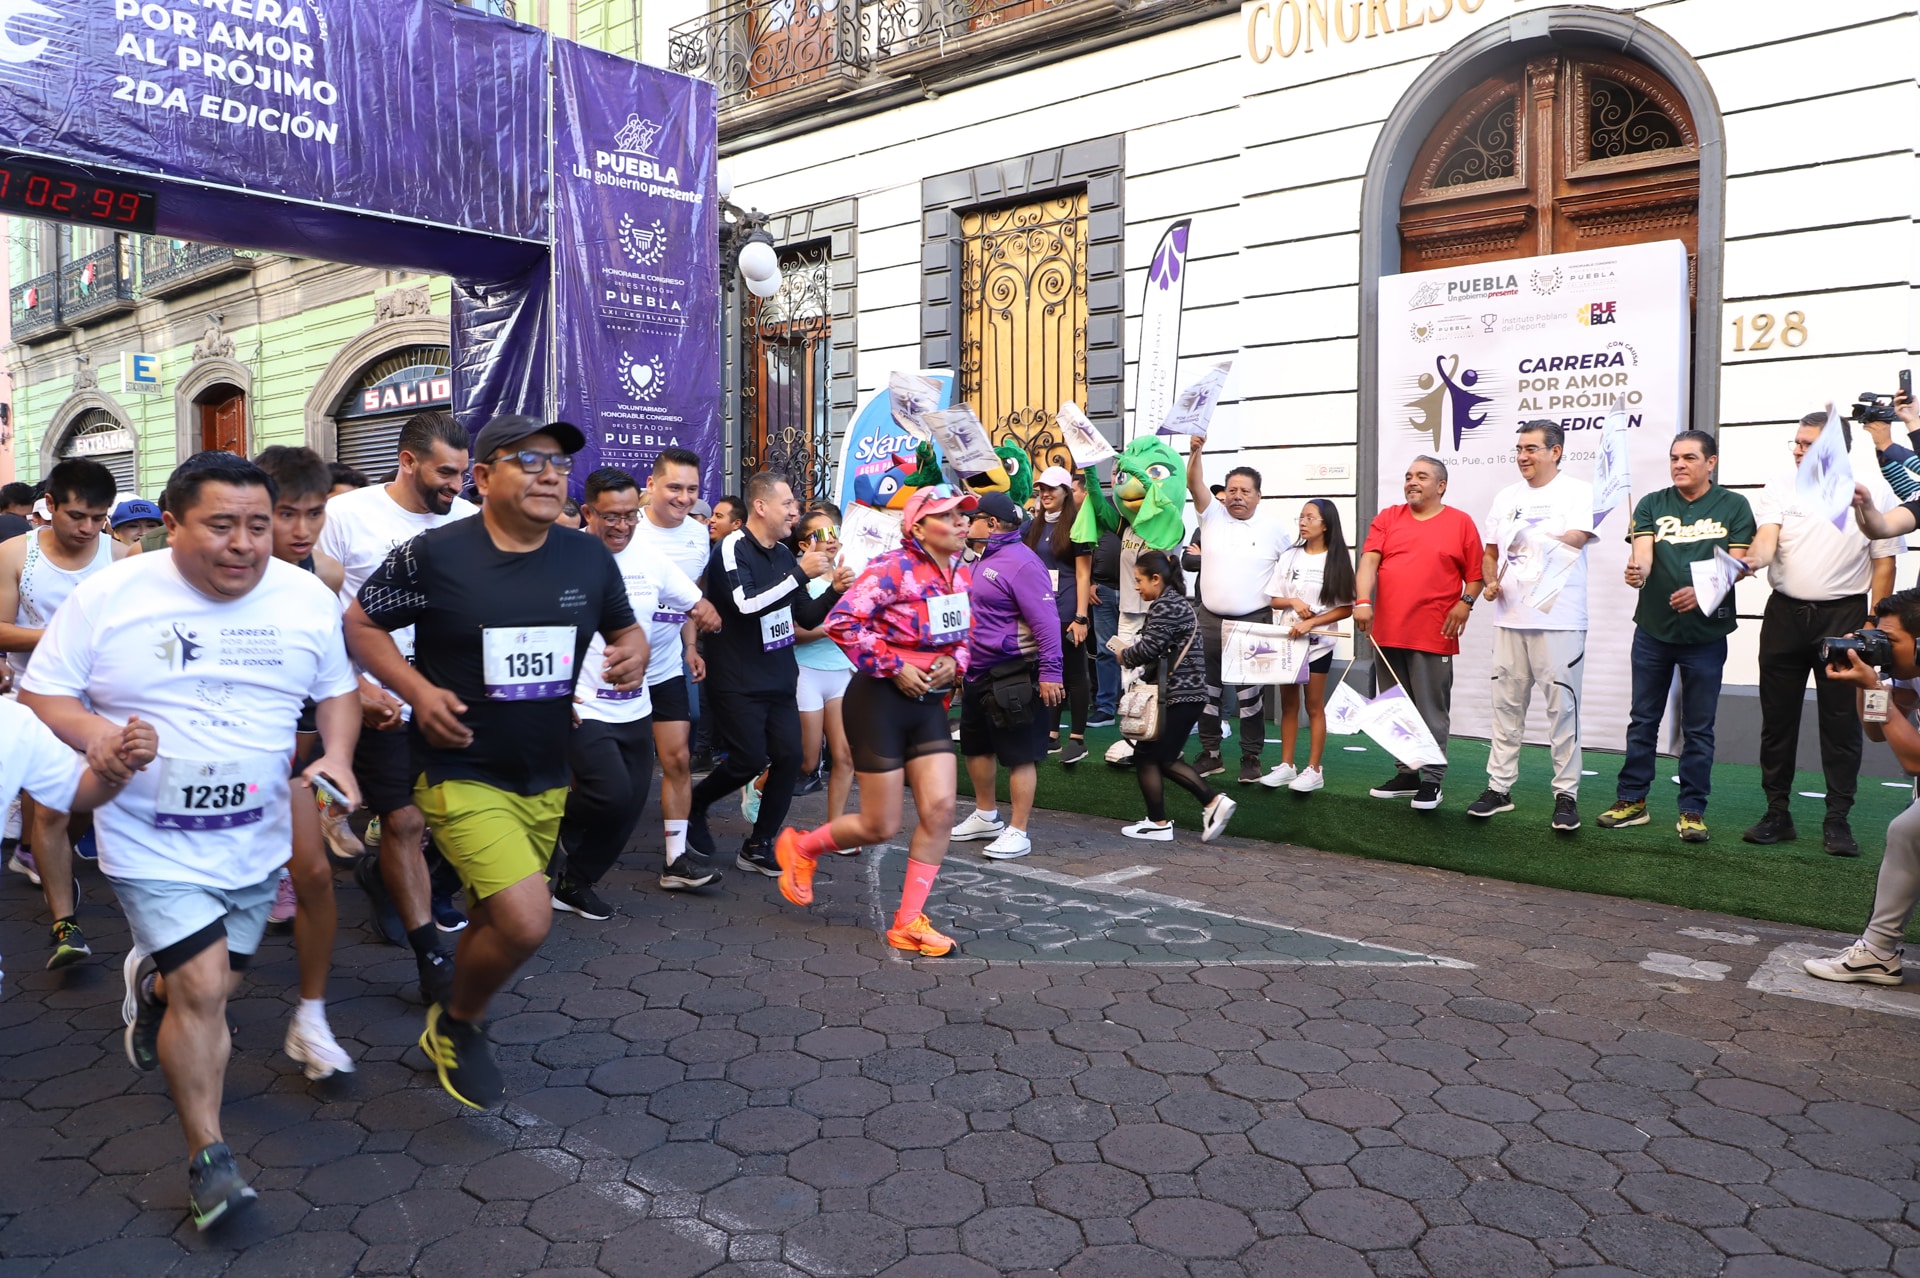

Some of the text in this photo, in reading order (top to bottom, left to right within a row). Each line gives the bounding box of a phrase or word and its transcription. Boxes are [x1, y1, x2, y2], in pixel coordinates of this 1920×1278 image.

[115, 0, 314, 69] POR AMOR
[115, 33, 338, 106] AL PRÓJIMO
[113, 75, 339, 145] 2DA EDICIÓN
[596, 150, 680, 186] PUEBLA
[572, 163, 704, 204] Un gobierno presente
[601, 267, 685, 286] HONORABLE CONGRESO
[1448, 274, 1519, 295] PUEBLA
[1570, 271, 1615, 281] PUEBLA
[626, 282, 665, 294] ESTADO
[1458, 292, 1488, 303] gobierno
[1487, 288, 1519, 300] presente
[606, 290, 682, 311] PUEBLA
[1590, 301, 1617, 315] PUE
[602, 308, 686, 324] LXI LEGISLATURA
[1502, 312, 1568, 325] Instituto Poblano
[1590, 312, 1616, 326] BLA
[1501, 322, 1546, 332] del Deporte
[1732, 311, 1808, 352] 128
[133, 355, 156, 383] E
[1518, 351, 1625, 374] CARRERA
[1518, 372, 1629, 393] POR AMOR
[364, 377, 451, 412] SALID
[617, 403, 668, 414] VOLUNTARIADO
[1518, 397, 1543, 411] AL
[600, 411, 683, 423] HONORABLE CONGRESO
[1562, 414, 1643, 431] EDICN
[626, 423, 664, 432] ESTADO
[76, 432, 128, 453] ENTRADA
[605, 432, 679, 447] PUEBLA
[1487, 457, 1494, 465] a
[1497, 455, 1507, 464] 16
[1508, 454, 1517, 464] d
[1570, 452, 1596, 461] 2024
[860, 463, 880, 475] AGUA
[128, 503, 152, 514] VANS
[1655, 516, 1728, 545] Puebla
[942, 610, 962, 628] 960
[220, 628, 275, 637] CARRERA
[770, 620, 790, 638] 1909
[504, 651, 553, 678] 1351
[181, 782, 246, 809] 1238
